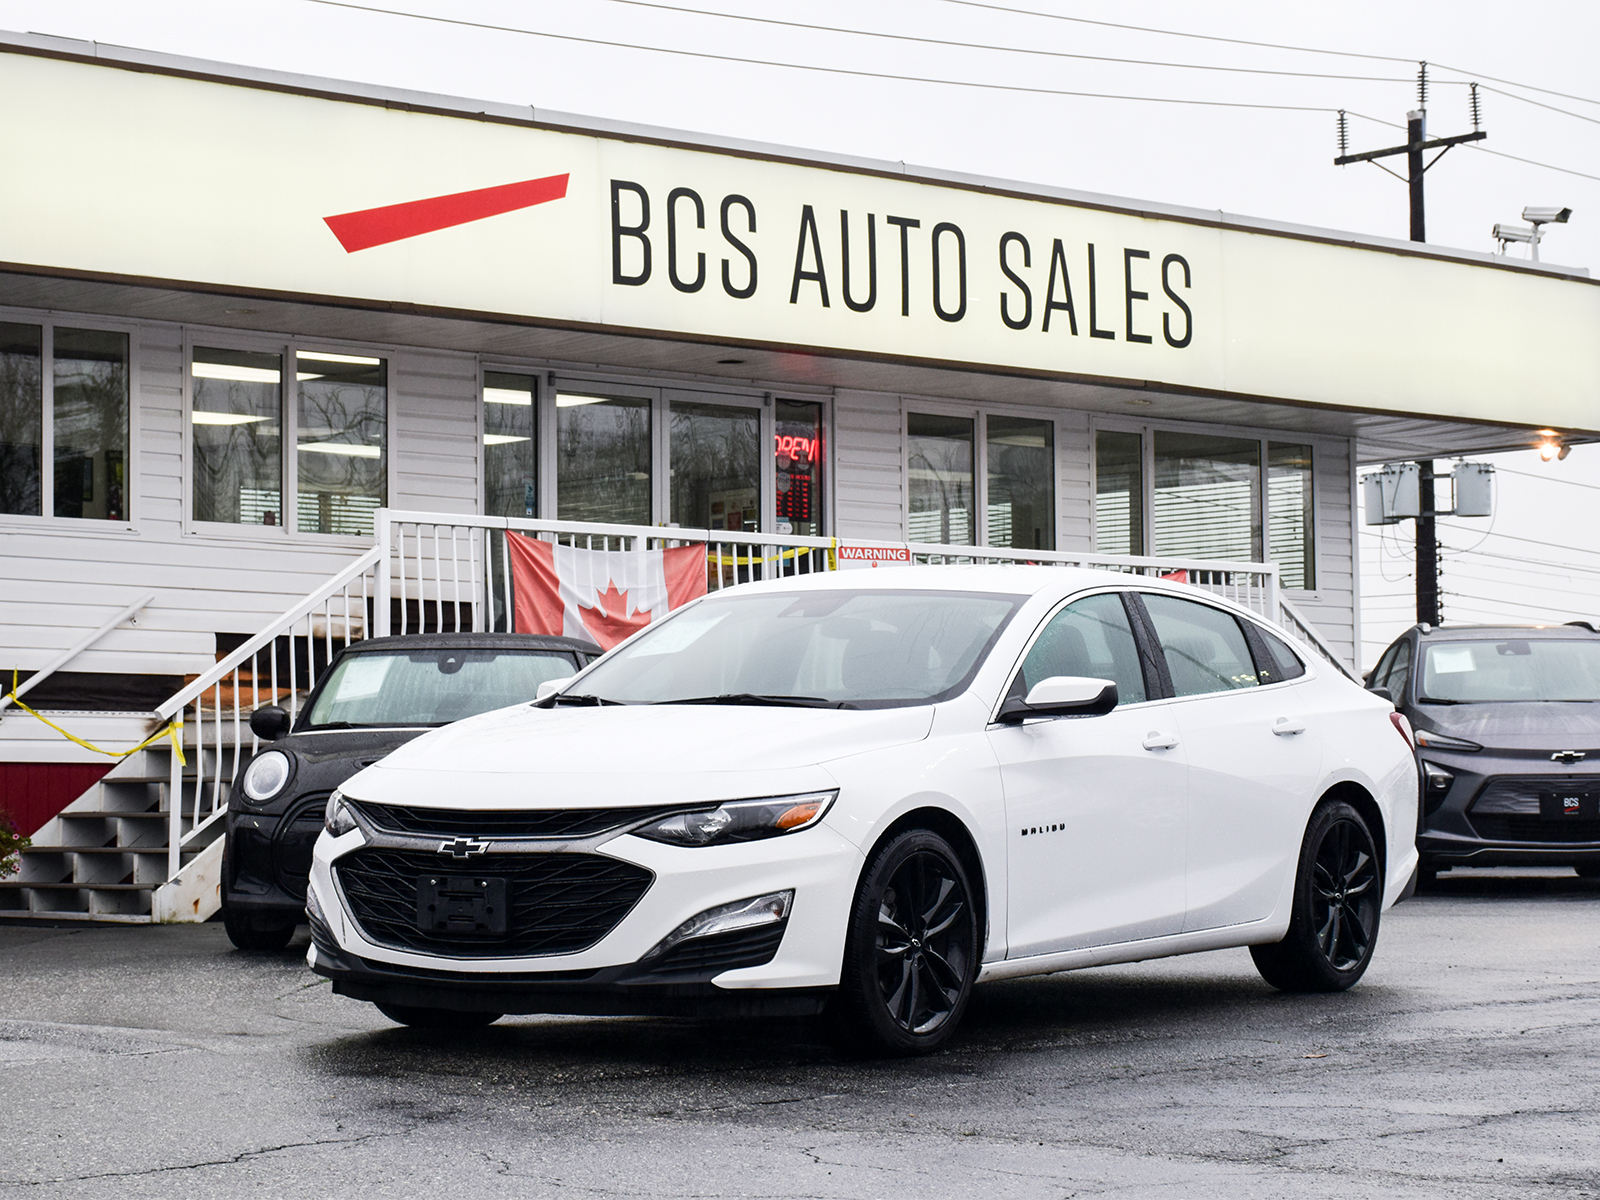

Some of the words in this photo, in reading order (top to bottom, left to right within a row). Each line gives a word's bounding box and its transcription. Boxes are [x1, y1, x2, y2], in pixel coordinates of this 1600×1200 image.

[610, 179, 759, 300] BCS
[789, 204, 967, 323] AUTO
[999, 231, 1193, 349] SALES
[841, 547, 907, 560] WARNING
[1564, 797, 1579, 807] BCS
[1021, 823, 1066, 836] MALIBU
